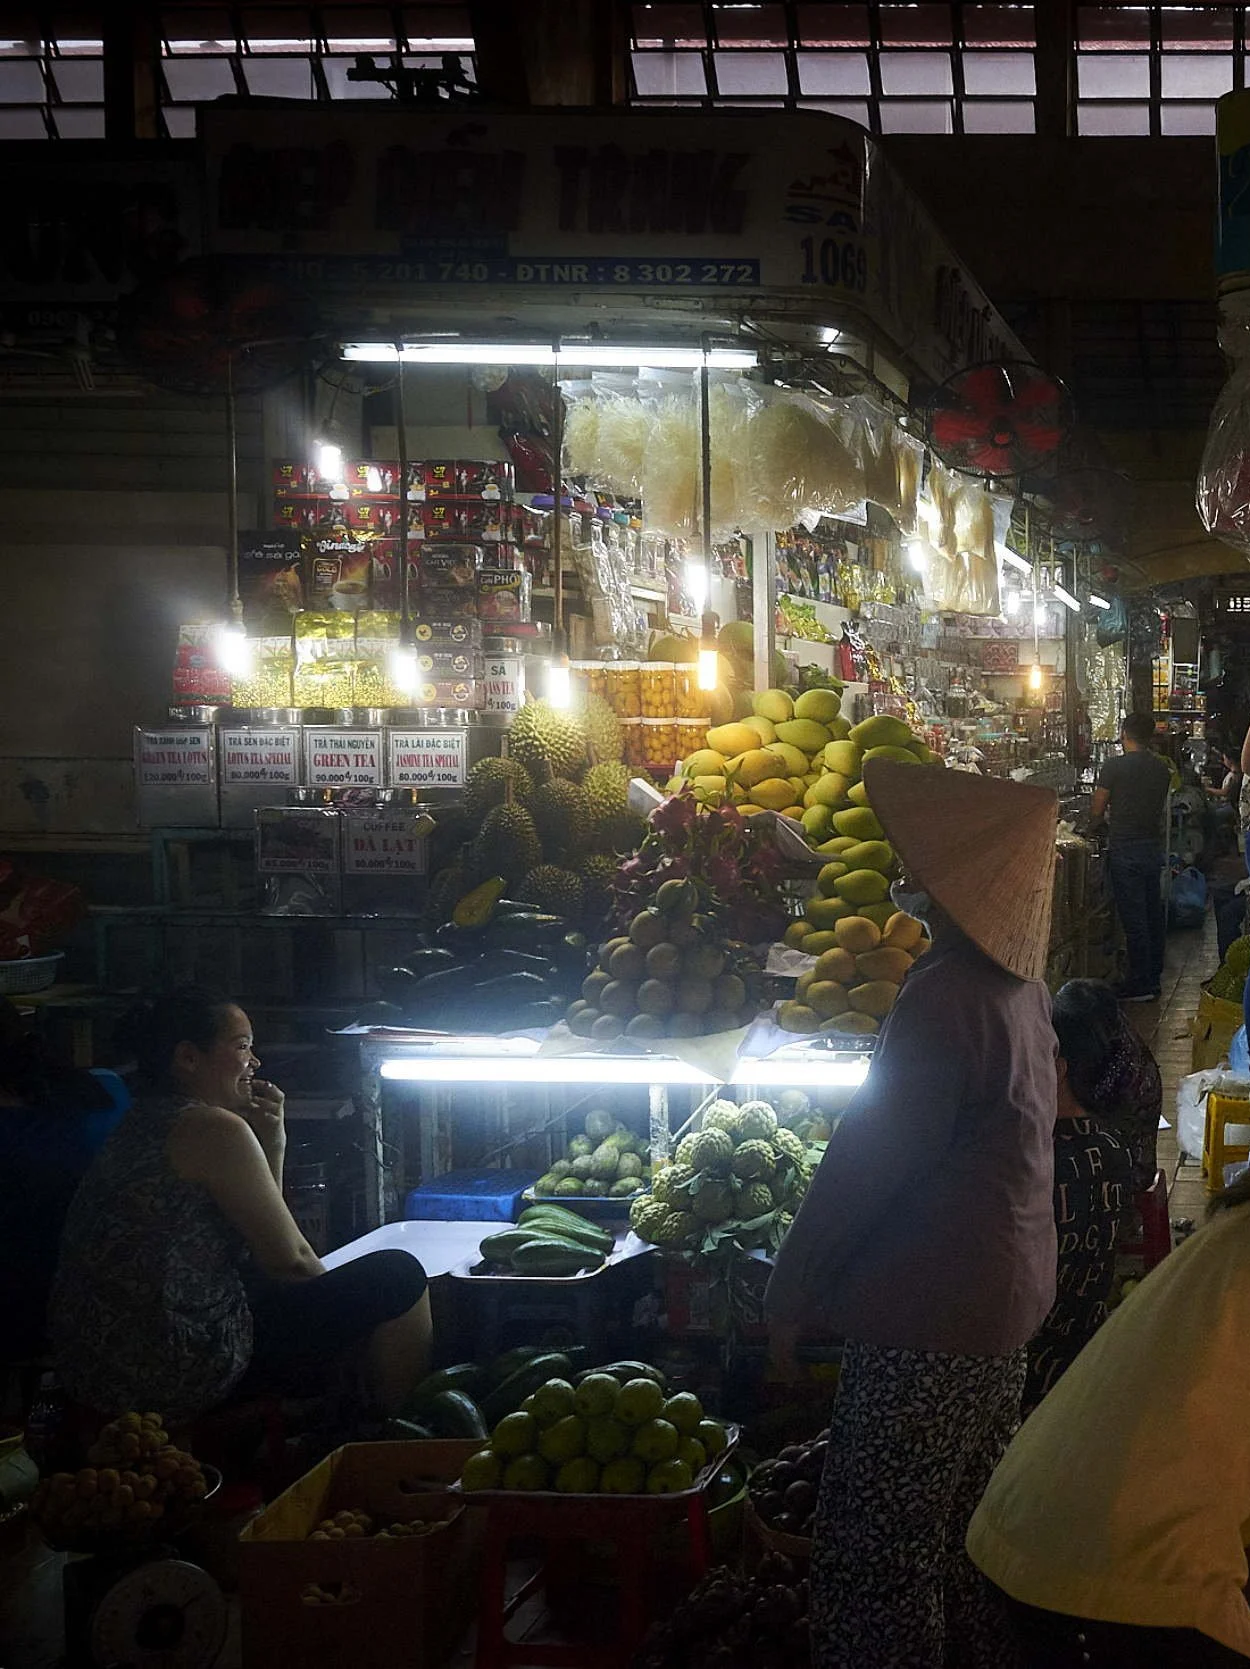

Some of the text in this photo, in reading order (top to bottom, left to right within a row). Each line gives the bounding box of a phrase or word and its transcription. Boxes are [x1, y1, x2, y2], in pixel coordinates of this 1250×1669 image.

[438, 264, 489, 282] 740
[515, 263, 589, 282] ĐTNR
[636, 264, 693, 282] 302
[700, 264, 754, 283] 272
[313, 753, 376, 768] GREEN TEA
[434, 754, 459, 768] SPECIAL
